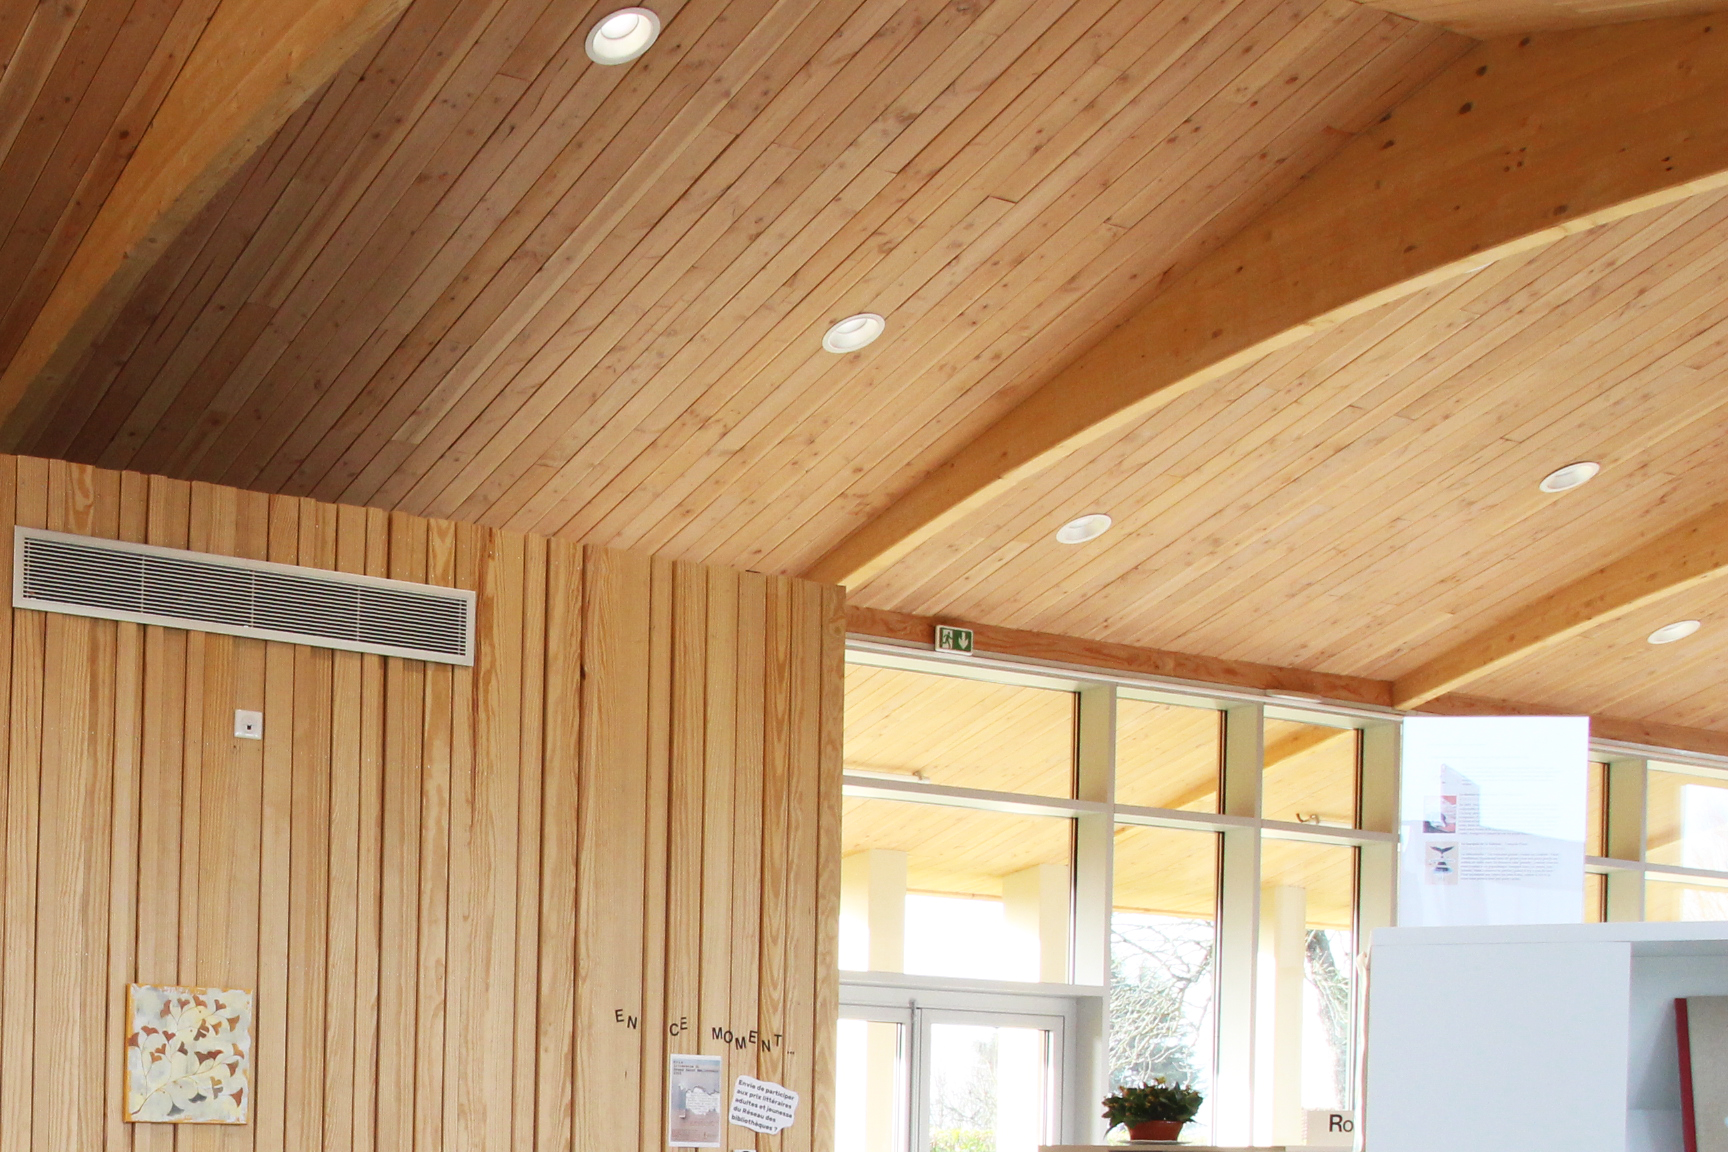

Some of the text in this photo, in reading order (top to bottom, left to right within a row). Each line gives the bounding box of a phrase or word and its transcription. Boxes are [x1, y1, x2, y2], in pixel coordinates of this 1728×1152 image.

[614, 1009, 638, 1030] EN
[669, 1017, 688, 1036] CE
[736, 1089, 792, 1109] aux prix littéraires
[738, 1080, 794, 1101] Envie de participer
[735, 1098, 758, 1109] adultes
[766, 1106, 792, 1118] jeunesse
[742, 1108, 764, 1120] Réseau
[765, 1114, 776, 1122] des
[732, 1115, 772, 1132] bibliothèques
